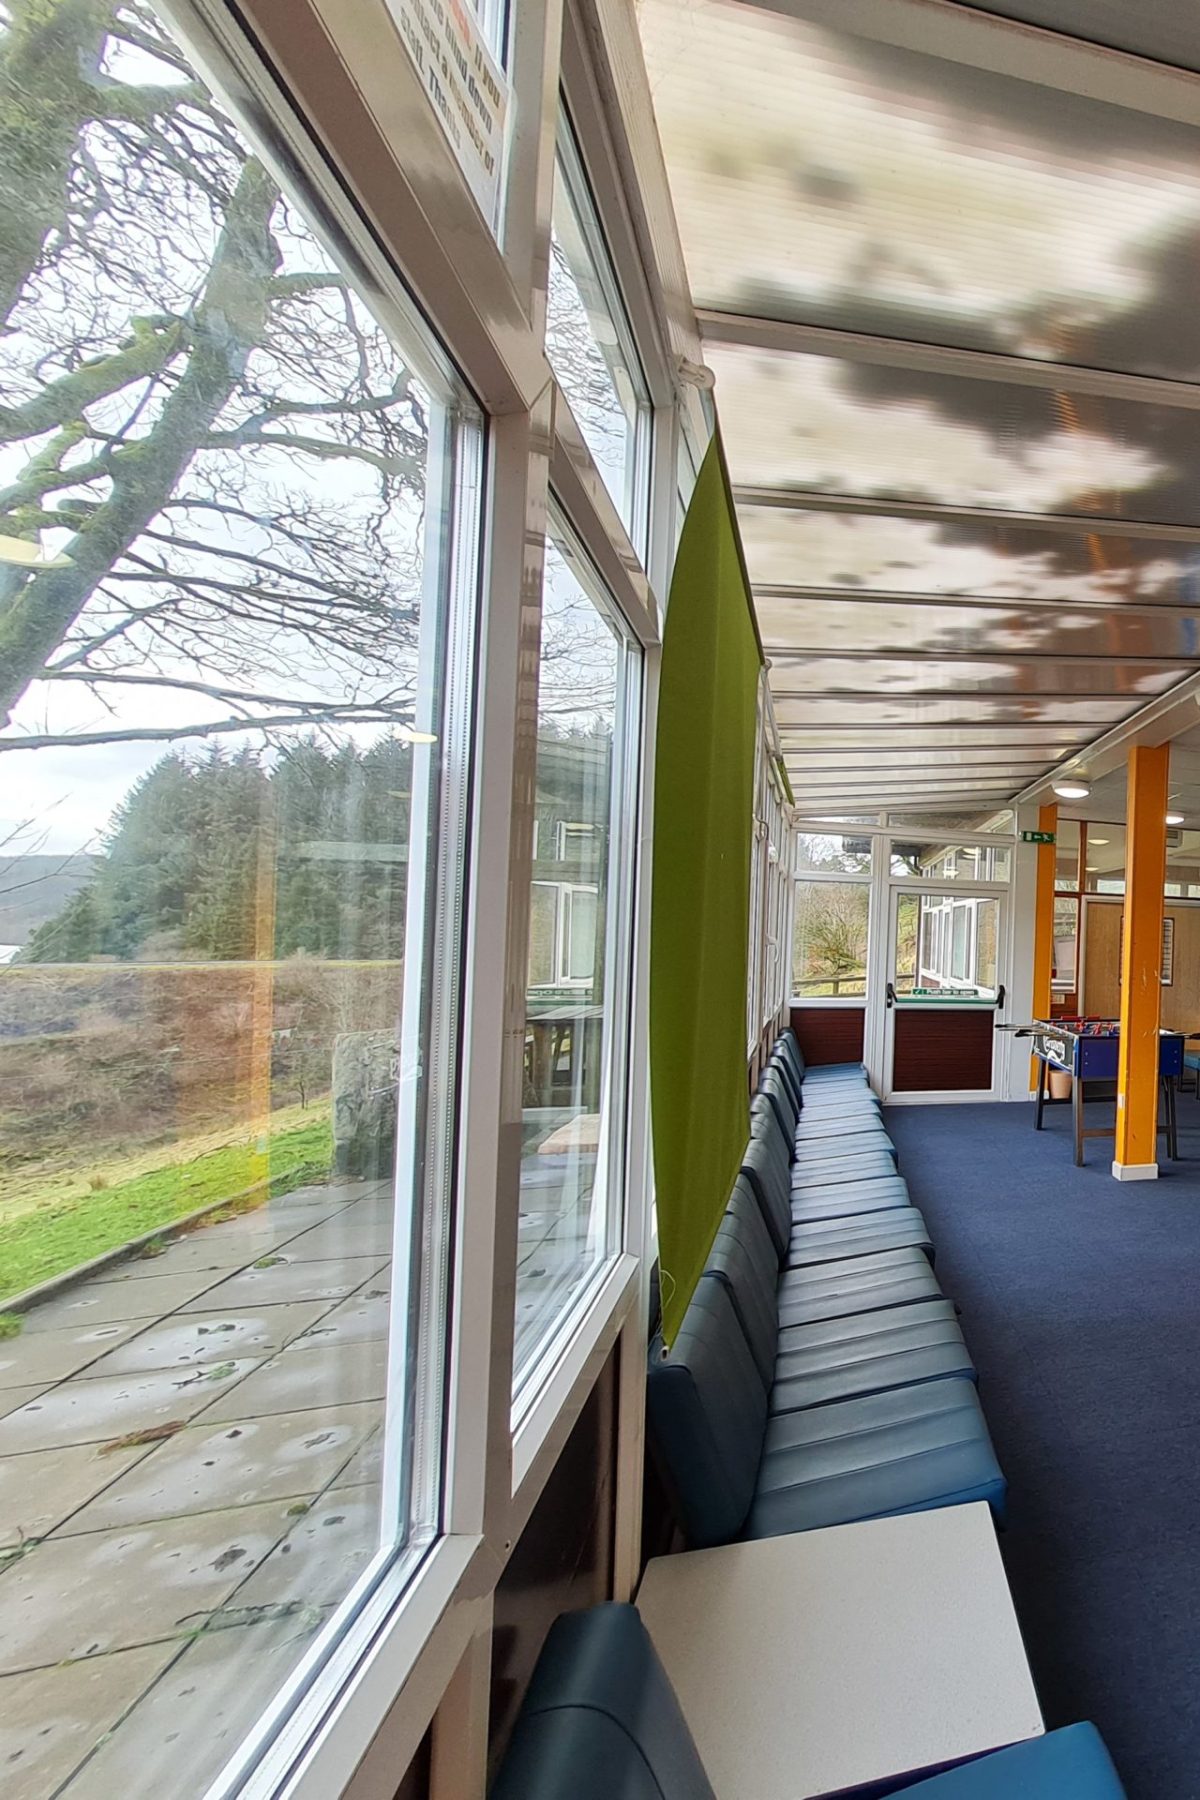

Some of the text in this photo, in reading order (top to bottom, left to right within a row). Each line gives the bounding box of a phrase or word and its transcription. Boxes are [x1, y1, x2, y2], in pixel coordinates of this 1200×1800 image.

[441, 54, 448, 79] a
[484, 150, 494, 176] of
[445, 18, 468, 82] blind
[468, 74, 493, 134] down
[482, 64, 500, 108] you
